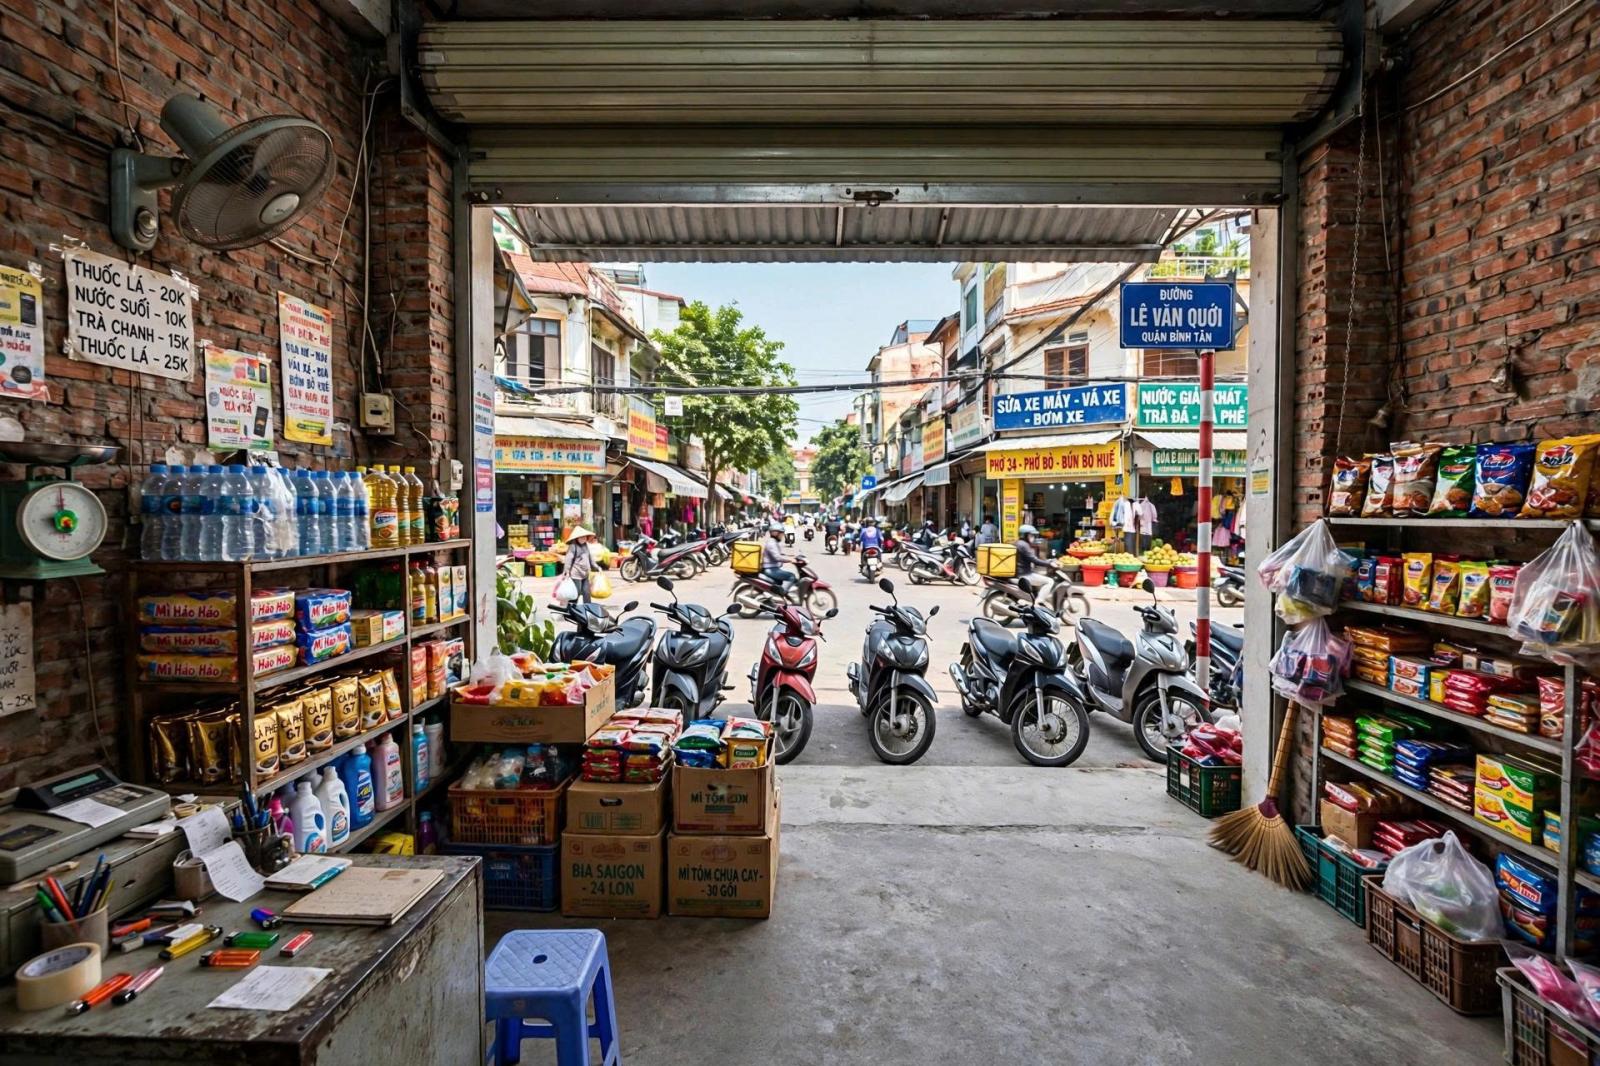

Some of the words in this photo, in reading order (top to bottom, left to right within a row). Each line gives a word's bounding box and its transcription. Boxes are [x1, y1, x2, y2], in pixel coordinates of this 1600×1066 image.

[72, 259, 121, 287] THUỐC
[127, 275, 144, 294] LÁ
[160, 286, 185, 306] 20K
[1160, 286, 1193, 300] ĐƯỜNG
[75, 285, 115, 309] NƯỚC
[165, 310, 187, 328] 10K
[1130, 303, 1148, 326] LÊ
[1152, 303, 1183, 327] VĂN
[1187, 303, 1222, 328] QUỚI
[76, 310, 106, 332] TRÀ
[111, 319, 154, 342] CHANH
[168, 333, 189, 351] 15K
[1141, 329, 1167, 344] QUẬN
[78, 335, 126, 359] THUỐC
[131, 346, 148, 365] LÁ
[164, 354, 188, 373] 25K
[997, 395, 1021, 413] SỬA
[1024, 397, 1040, 411] XE
[1043, 391, 1071, 409] MÁY
[1082, 388, 1100, 407] VÁ
[1103, 390, 1120, 405] XE
[1141, 386, 1176, 405] NƯỚC
[1033, 410, 1063, 425] BƠM
[1066, 410, 1084, 424] XE
[1143, 405, 1168, 424] TRÀ
[1171, 405, 1189, 424] ĐÁ
[1007, 458, 1017, 472] 34
[1043, 452, 1054, 470] BÒ
[1062, 450, 1079, 469] BÚN
[1082, 450, 1094, 468] BÒ
[343, 702, 355, 714] G7
[313, 714, 328, 727] G7
[287, 727, 301, 740] G7
[259, 737, 274, 752] G7
[573, 863, 592, 879] BIA
[597, 864, 645, 880] SAIGON
[590, 881, 605, 896] 24
[609, 882, 634, 896] LON
[707, 884, 718, 896] 30
[720, 882, 737, 897] GÓI
